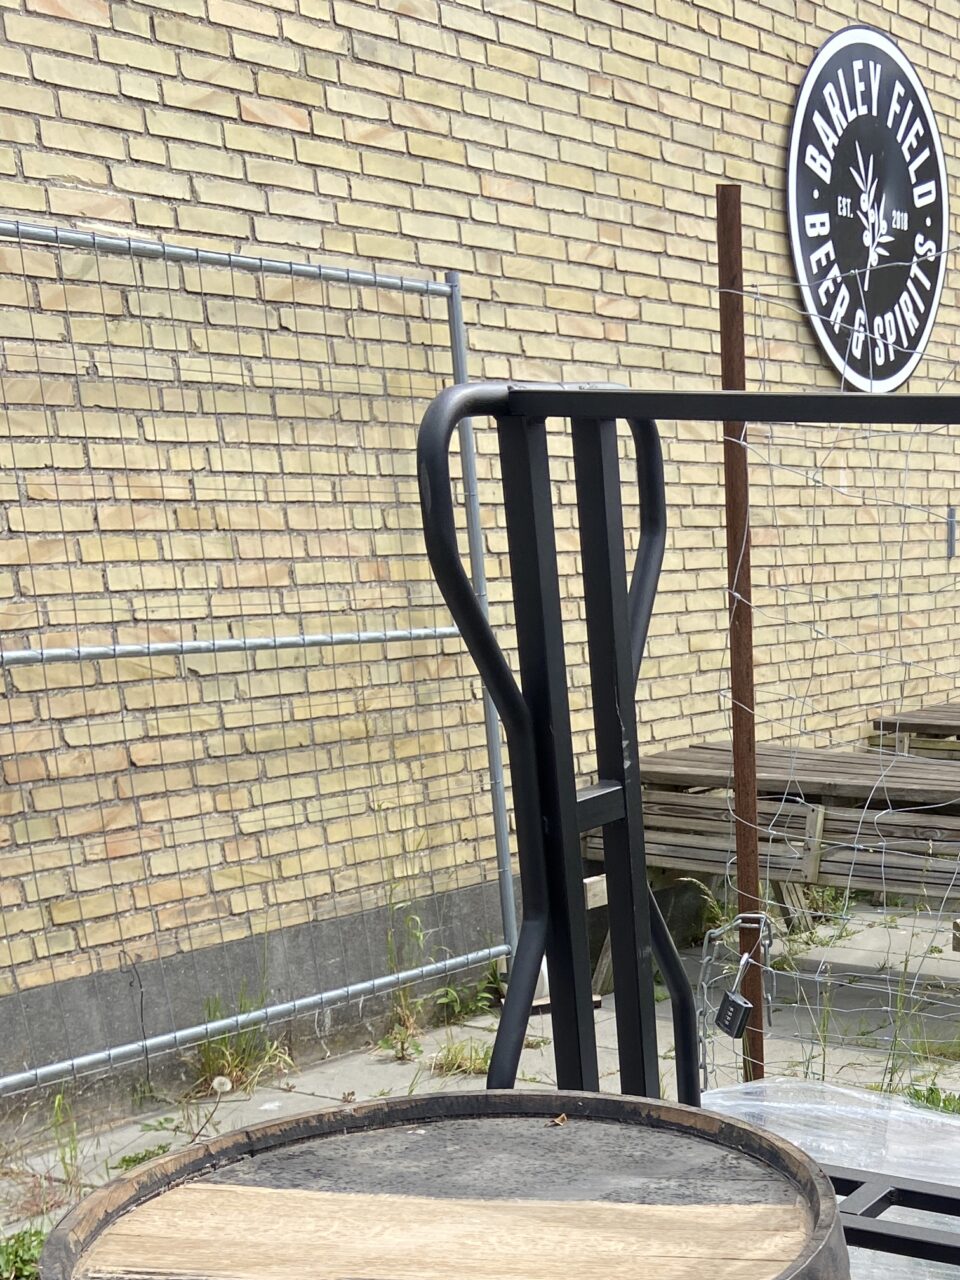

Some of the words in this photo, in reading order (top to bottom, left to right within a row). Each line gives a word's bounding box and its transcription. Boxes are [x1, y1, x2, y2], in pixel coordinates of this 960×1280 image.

[805, 60, 881, 185] BARLEY
[886, 80, 937, 208] FIELD
[837, 195, 854, 218] EST.
[804, 212, 850, 335] BEER
[851, 308, 866, 360] &
[873, 233, 937, 366] SPIRITS
